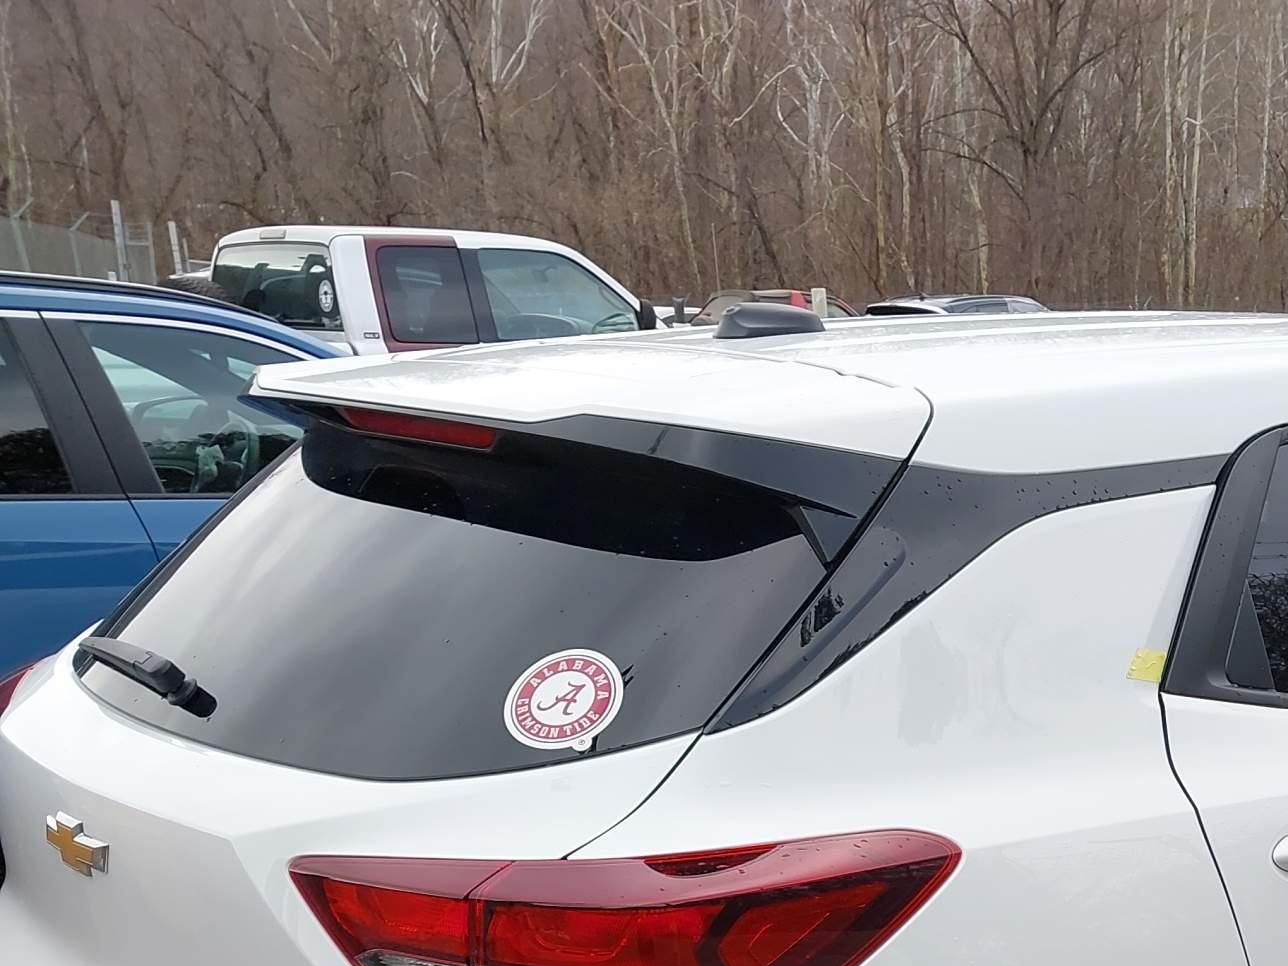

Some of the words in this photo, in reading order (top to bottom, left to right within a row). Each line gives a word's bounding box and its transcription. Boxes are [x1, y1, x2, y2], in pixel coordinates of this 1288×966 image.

[529, 660, 609, 700] ALABAMA
[517, 698, 560, 738] CRIMSON
[563, 710, 600, 736] TIDE
